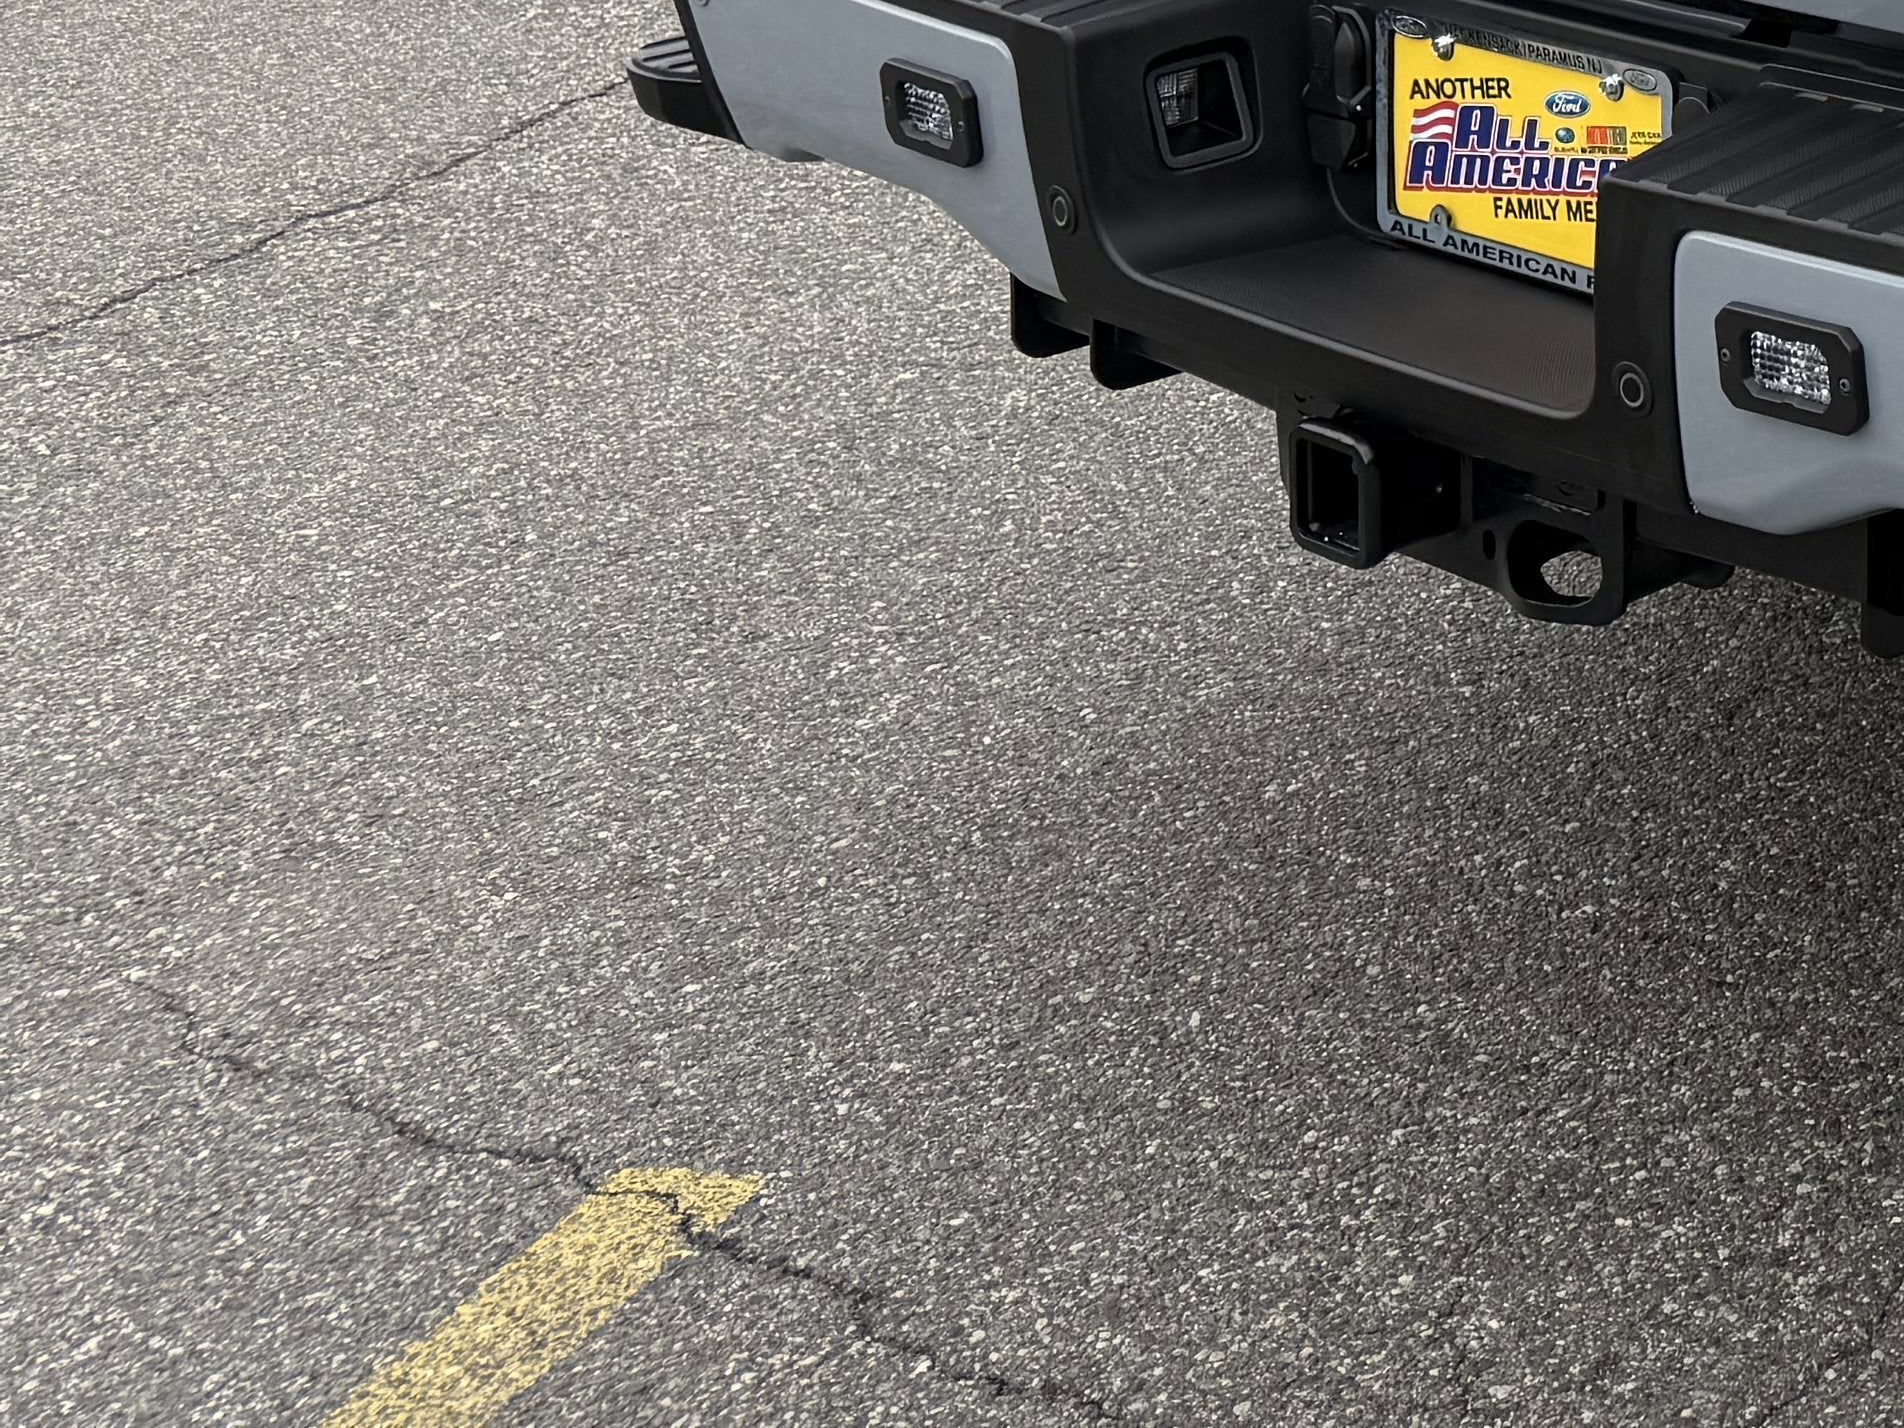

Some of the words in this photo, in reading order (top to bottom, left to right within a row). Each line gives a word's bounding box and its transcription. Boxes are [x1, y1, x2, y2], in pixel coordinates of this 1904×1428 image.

[1527, 43, 1585, 70] PARAMUS
[1587, 55, 1604, 75] NJ
[1410, 77, 1511, 100] ANOTHER
[1552, 94, 1583, 115] Ford
[1454, 104, 1552, 153] ALL
[1493, 197, 1560, 221] FAMILY
[1390, 219, 1437, 245] ALL
[1443, 237, 1578, 285] AMERICAN
